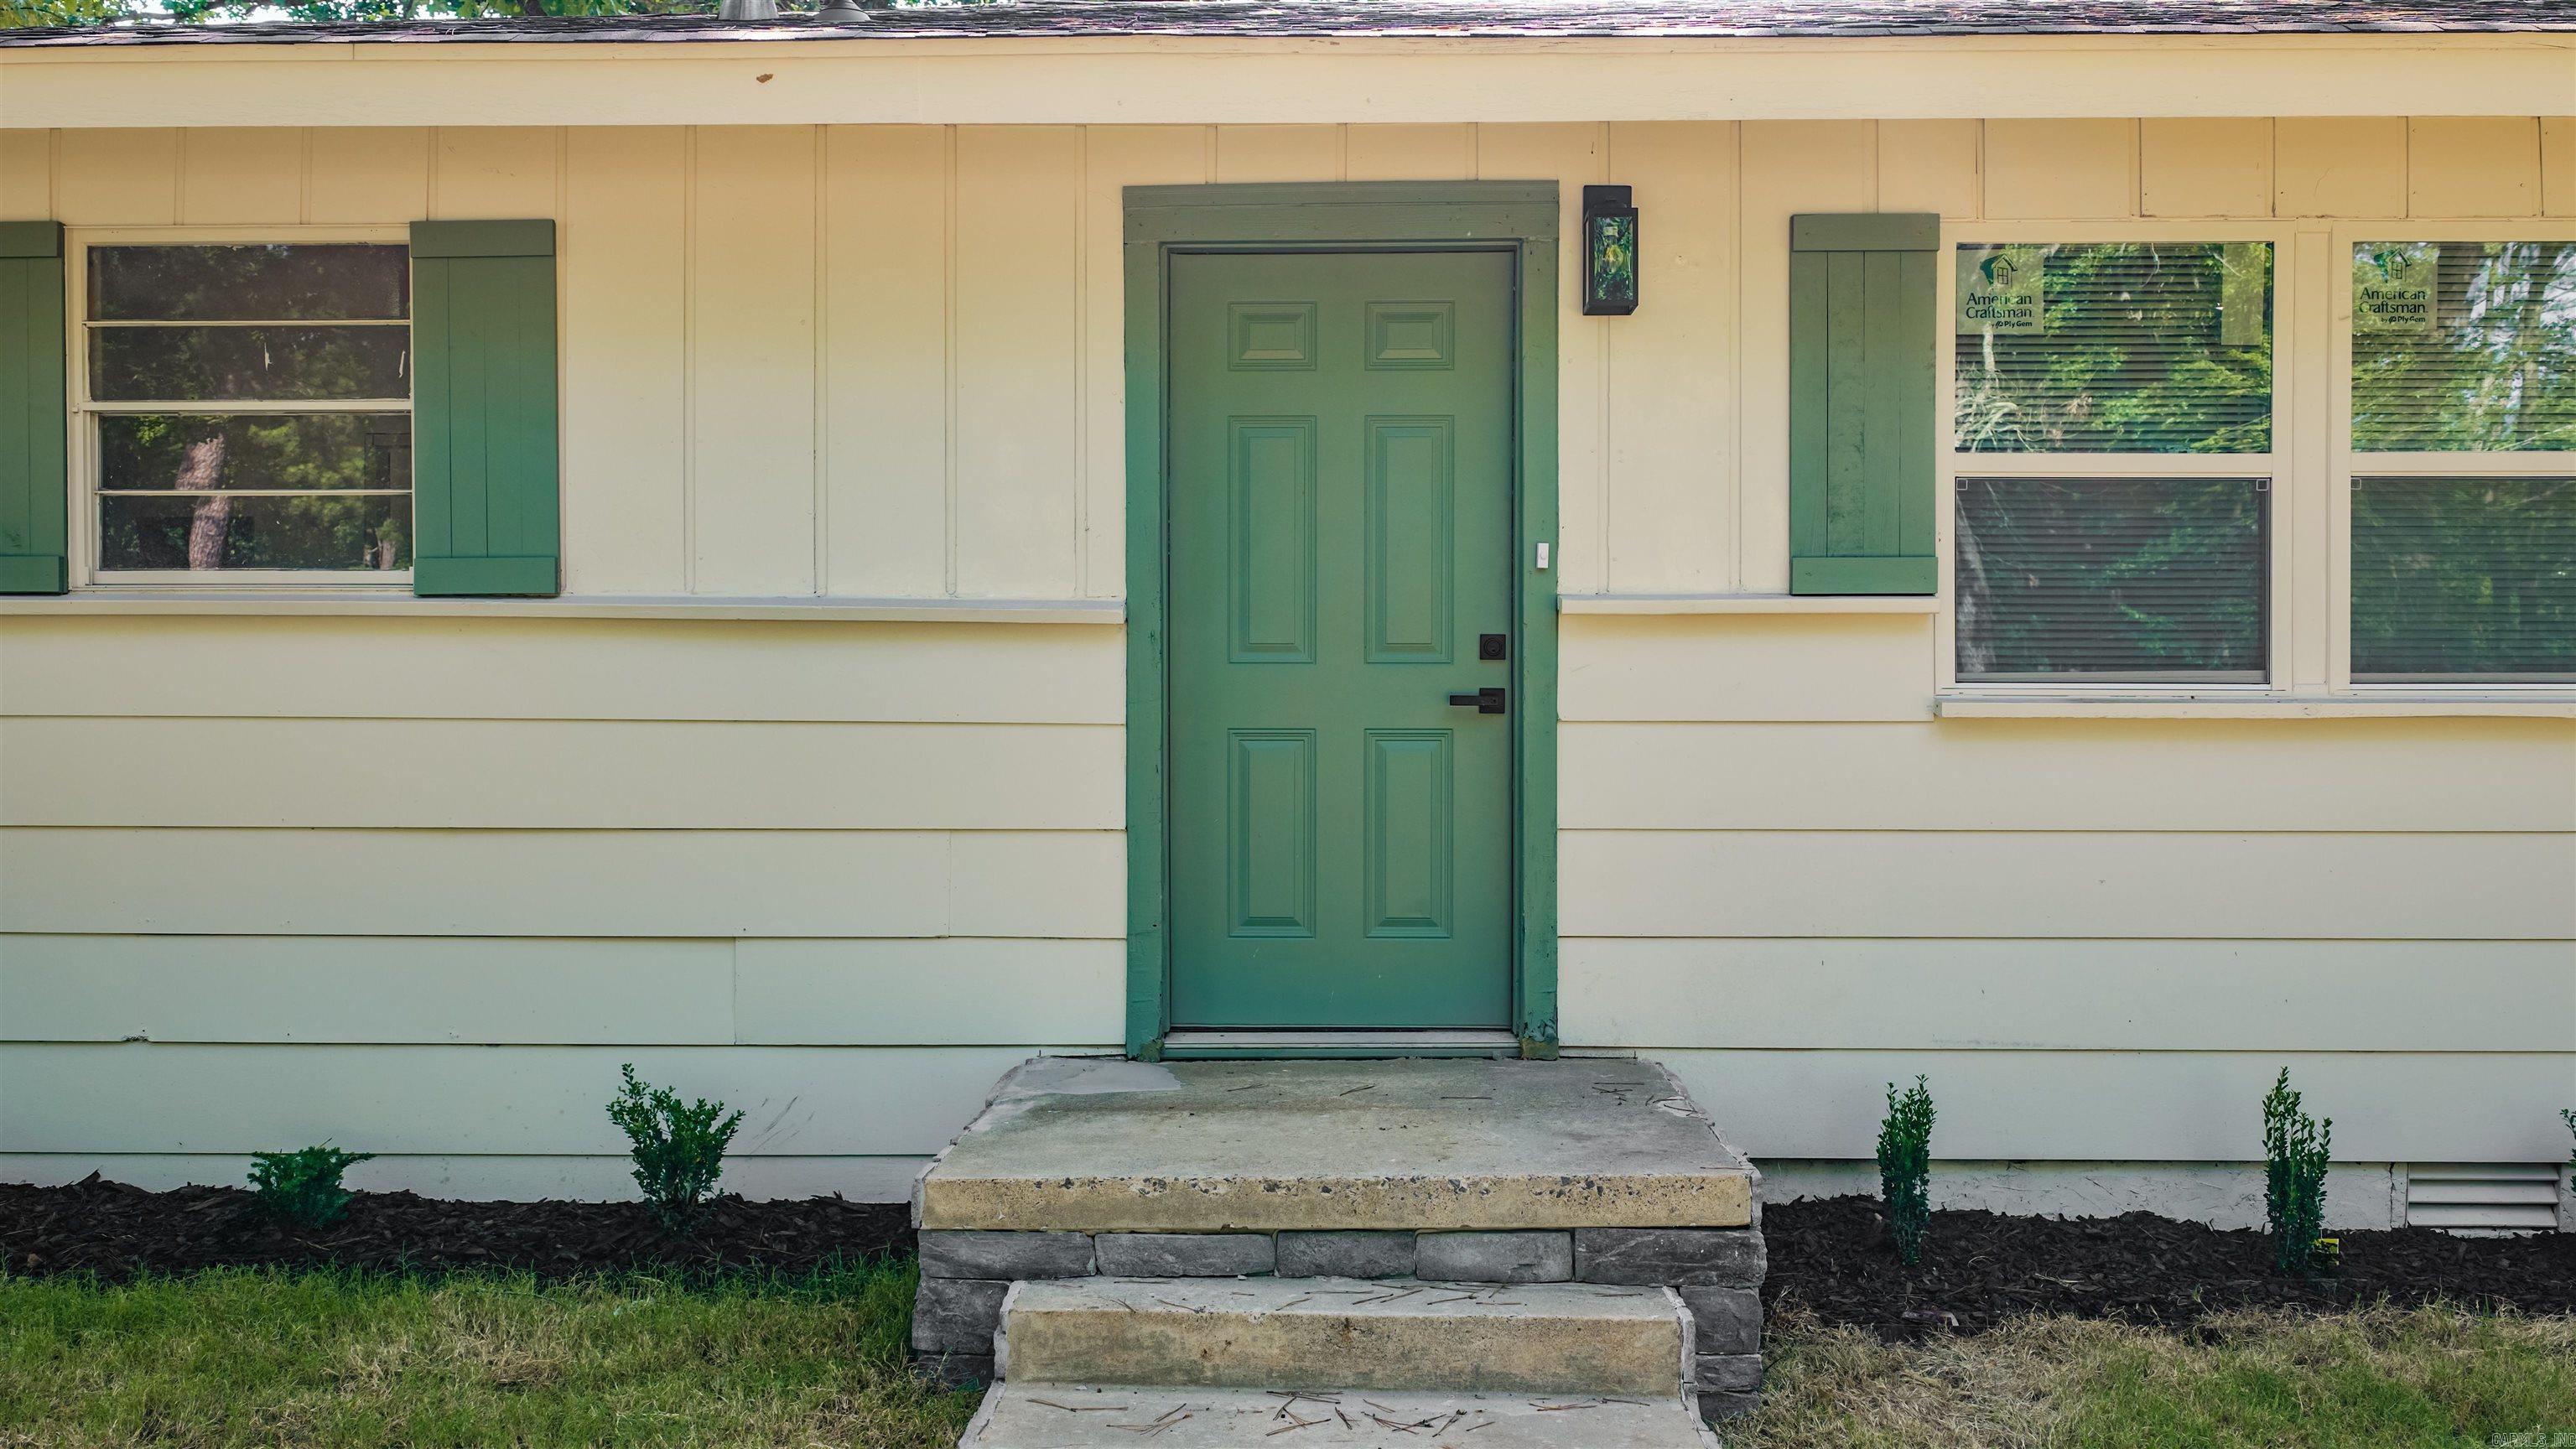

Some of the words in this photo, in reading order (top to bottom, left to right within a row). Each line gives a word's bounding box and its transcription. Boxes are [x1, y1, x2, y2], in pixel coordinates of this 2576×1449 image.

[1966, 293, 2032, 305] American
[2360, 288, 2425, 299] American
[1966, 306, 2032, 319] Craftsman
[2359, 300, 2426, 314] Craftsman
